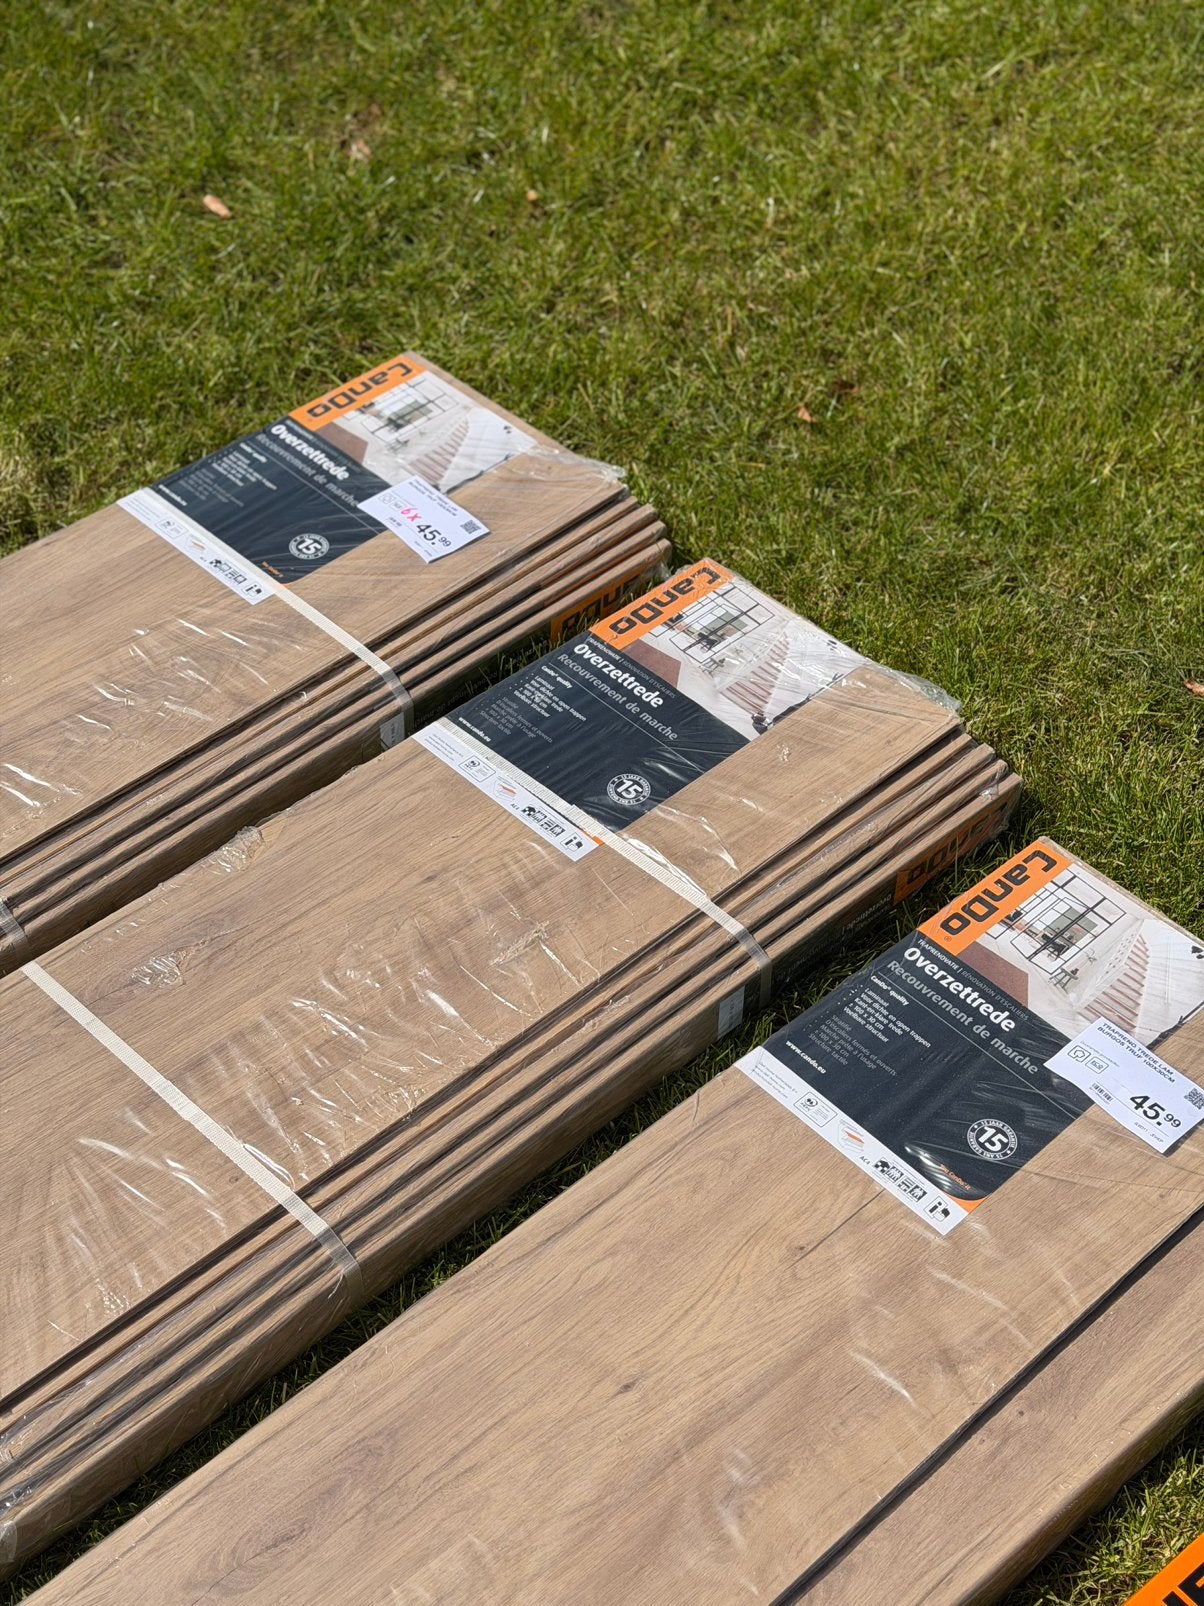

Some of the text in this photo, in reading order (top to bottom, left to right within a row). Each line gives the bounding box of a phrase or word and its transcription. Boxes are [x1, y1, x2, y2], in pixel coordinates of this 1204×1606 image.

[307, 362, 412, 417] CanDo
[271, 425, 349, 480] Overzettrede
[298, 538, 321, 554] 15
[609, 567, 721, 635] CanDo
[574, 643, 663, 708] Overzettrede
[558, 654, 627, 704] Recouvrement
[625, 702, 640, 714] de
[640, 712, 677, 740] marche
[616, 779, 642, 798] 15
[940, 850, 1057, 936] CanDo
[917, 939, 960, 970] TRAPRENOVATIE
[865, 988, 890, 1007] Laminaat
[889, 988, 910, 1006] quality
[904, 947, 1016, 1032] Overzettrede
[853, 1004, 864, 1015] 100
[875, 1022, 884, 1031] cm
[854, 997, 903, 1036] Kant-en-klare trede
[860, 993, 931, 1048] Voor dichte en open trappen
[887, 960, 974, 1026] Recouvrement
[973, 1023, 990, 1039] de
[990, 1038, 1039, 1075] marche
[1097, 1026, 1125, 1046] BURGOS
[786, 1040, 826, 1074] www.cando.eu
[1137, 1046, 1158, 1065] TREDE
[1158, 1062, 1174, 1076] LAM
[978, 1126, 1008, 1151] 15
